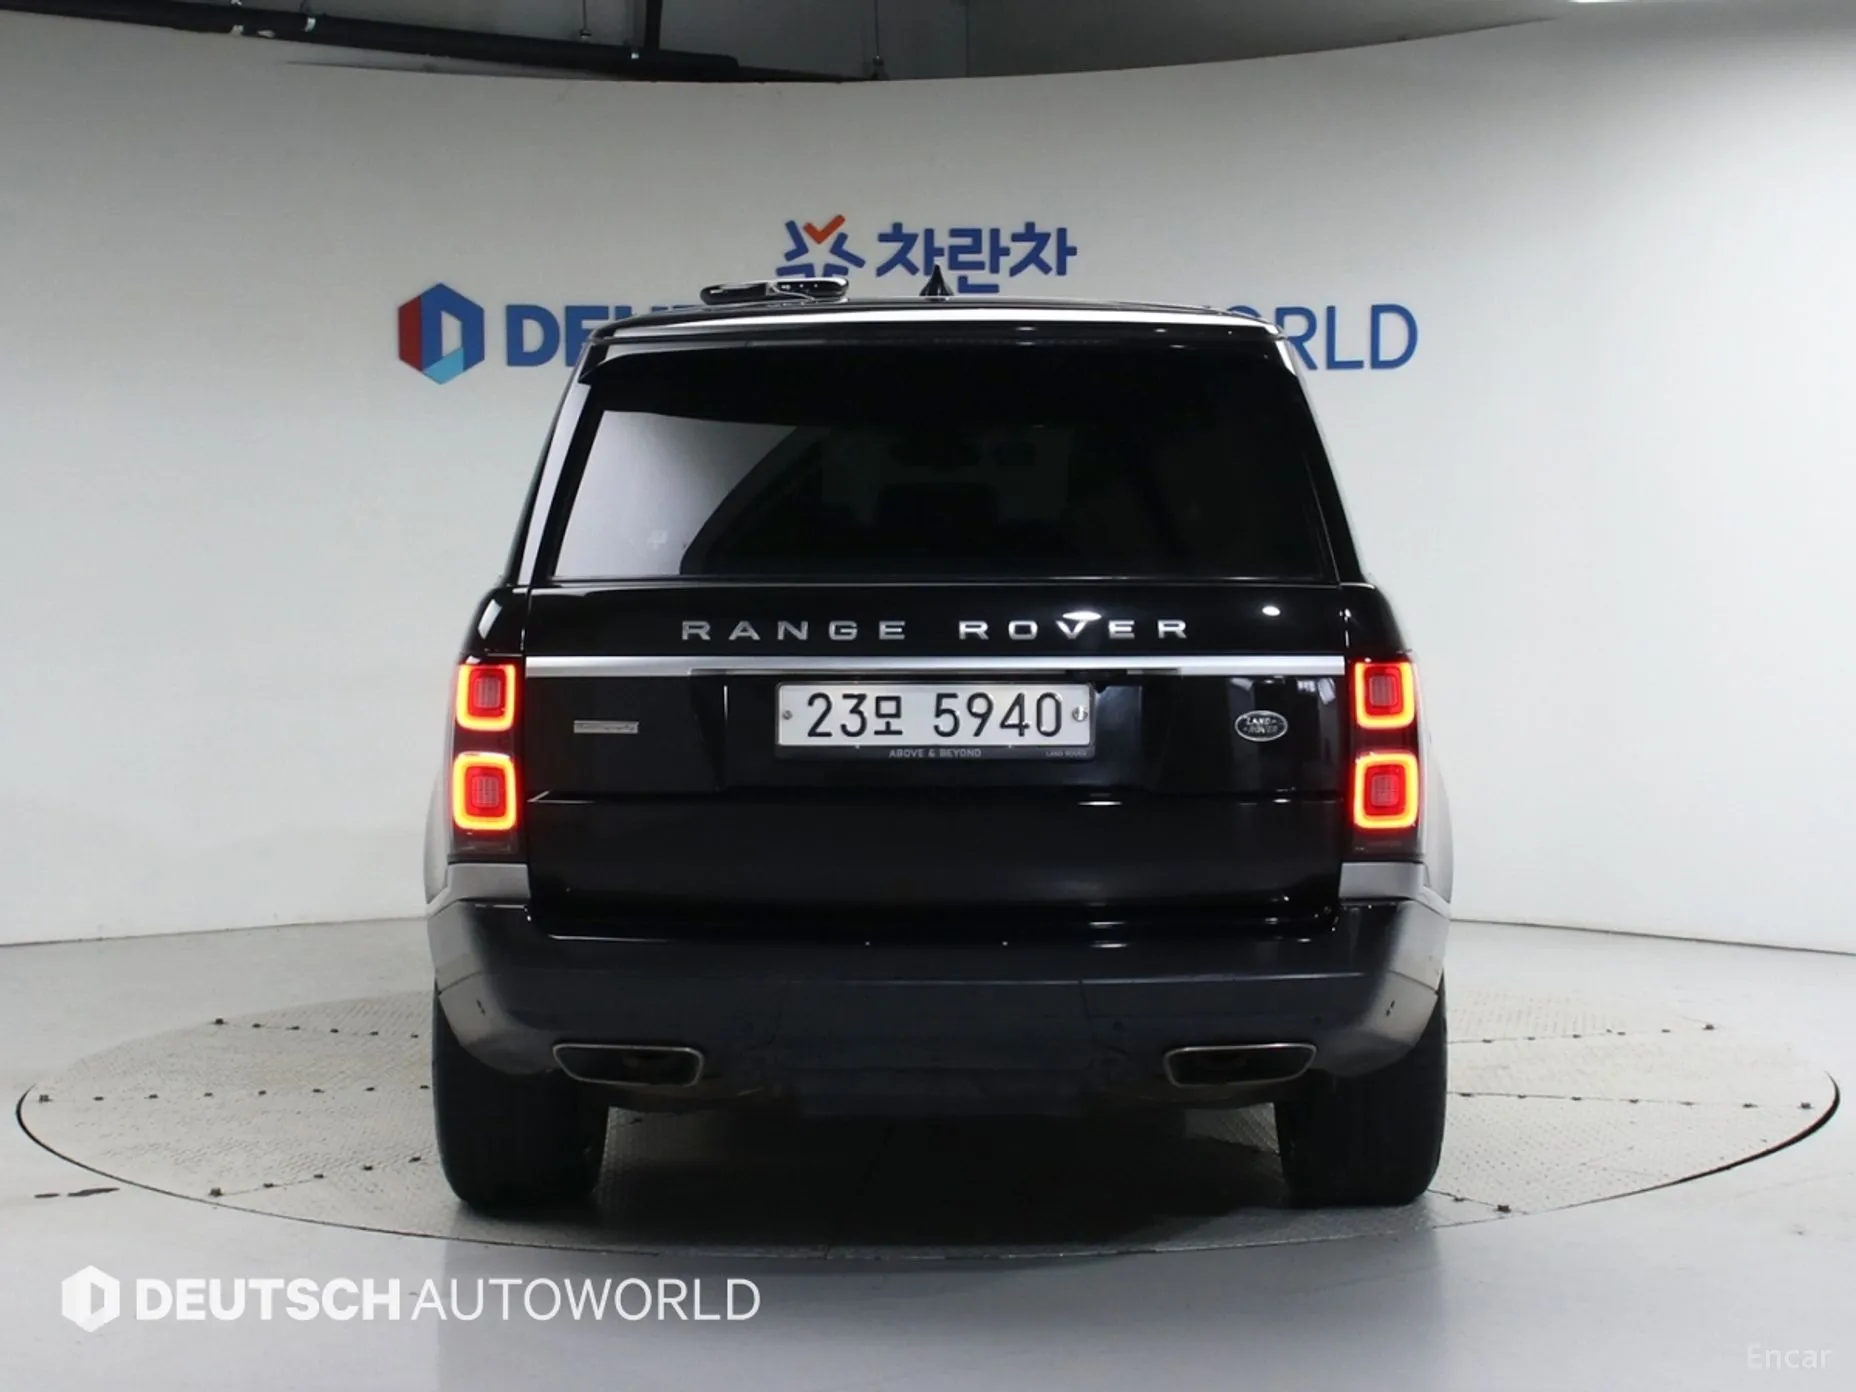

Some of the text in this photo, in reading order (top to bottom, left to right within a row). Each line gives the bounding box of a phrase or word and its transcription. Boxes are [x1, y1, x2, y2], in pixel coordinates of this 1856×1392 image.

[876, 221, 1078, 295] 차란차
[681, 618, 1187, 641] RANGE ROVER
[807, 692, 1062, 738] 23모 5940
[888, 748, 925, 758] ABOVE
[939, 748, 982, 758] BEYOND
